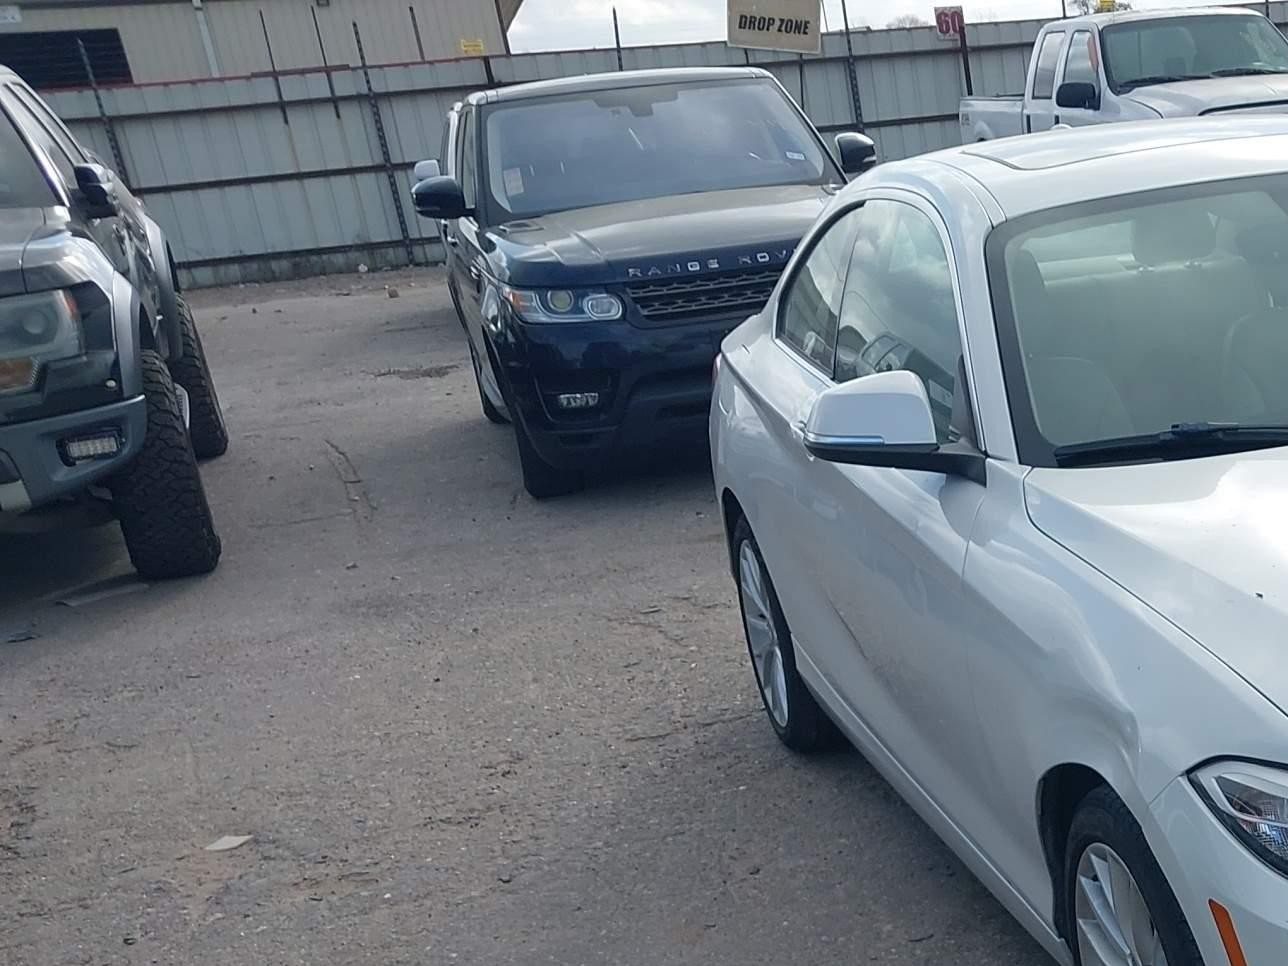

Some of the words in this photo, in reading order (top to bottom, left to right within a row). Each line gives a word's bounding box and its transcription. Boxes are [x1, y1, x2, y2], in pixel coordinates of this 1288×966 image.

[738, 14, 775, 32] DROP
[777, 18, 810, 35] ZONE
[936, 10, 964, 33] 60
[628, 259, 720, 277] RANGE
[738, 250, 788, 265] ROV
